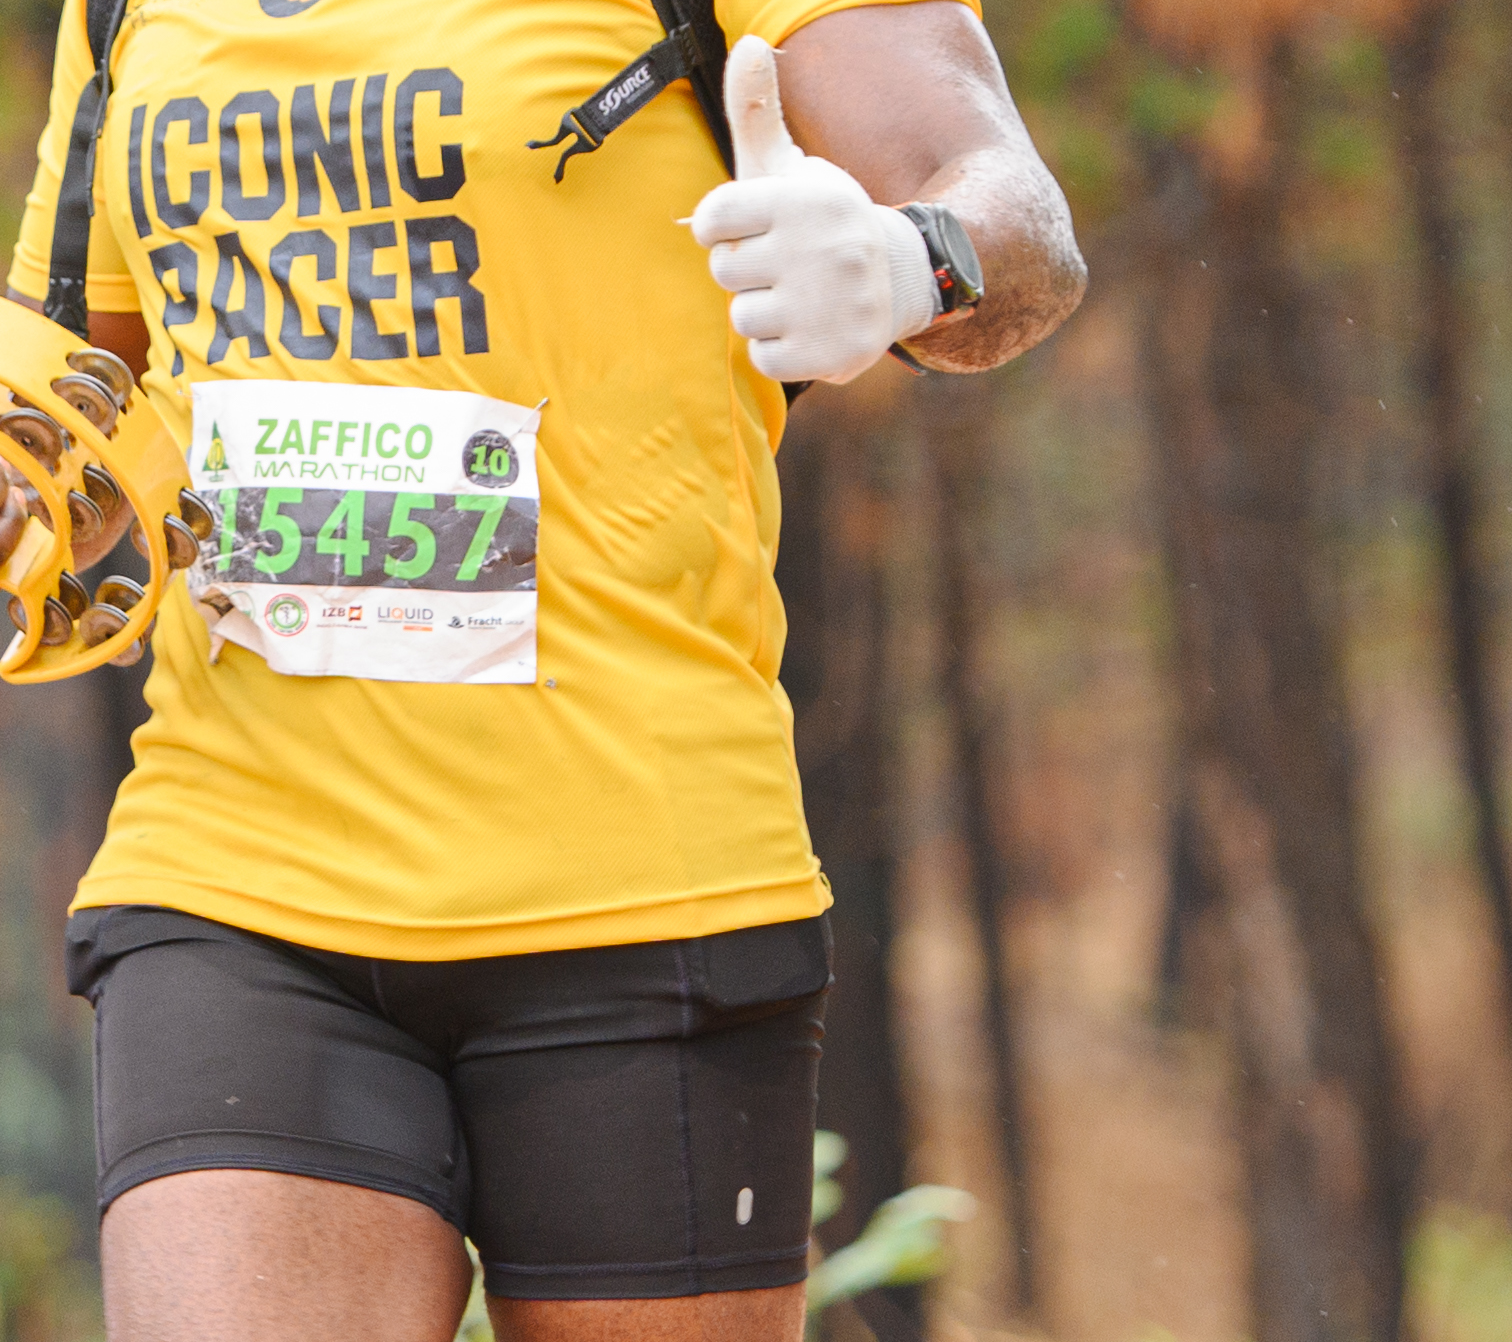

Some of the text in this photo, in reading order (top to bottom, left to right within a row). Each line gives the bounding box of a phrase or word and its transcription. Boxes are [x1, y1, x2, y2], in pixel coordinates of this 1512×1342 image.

[129, 66, 466, 238] ICONIC
[147, 214, 490, 377] PACER
[253, 460, 426, 484] MARATHON
[255, 418, 510, 478] ZAFFICO 10
[215, 486, 510, 583] 15457
[377, 606, 434, 621] LIQUID
